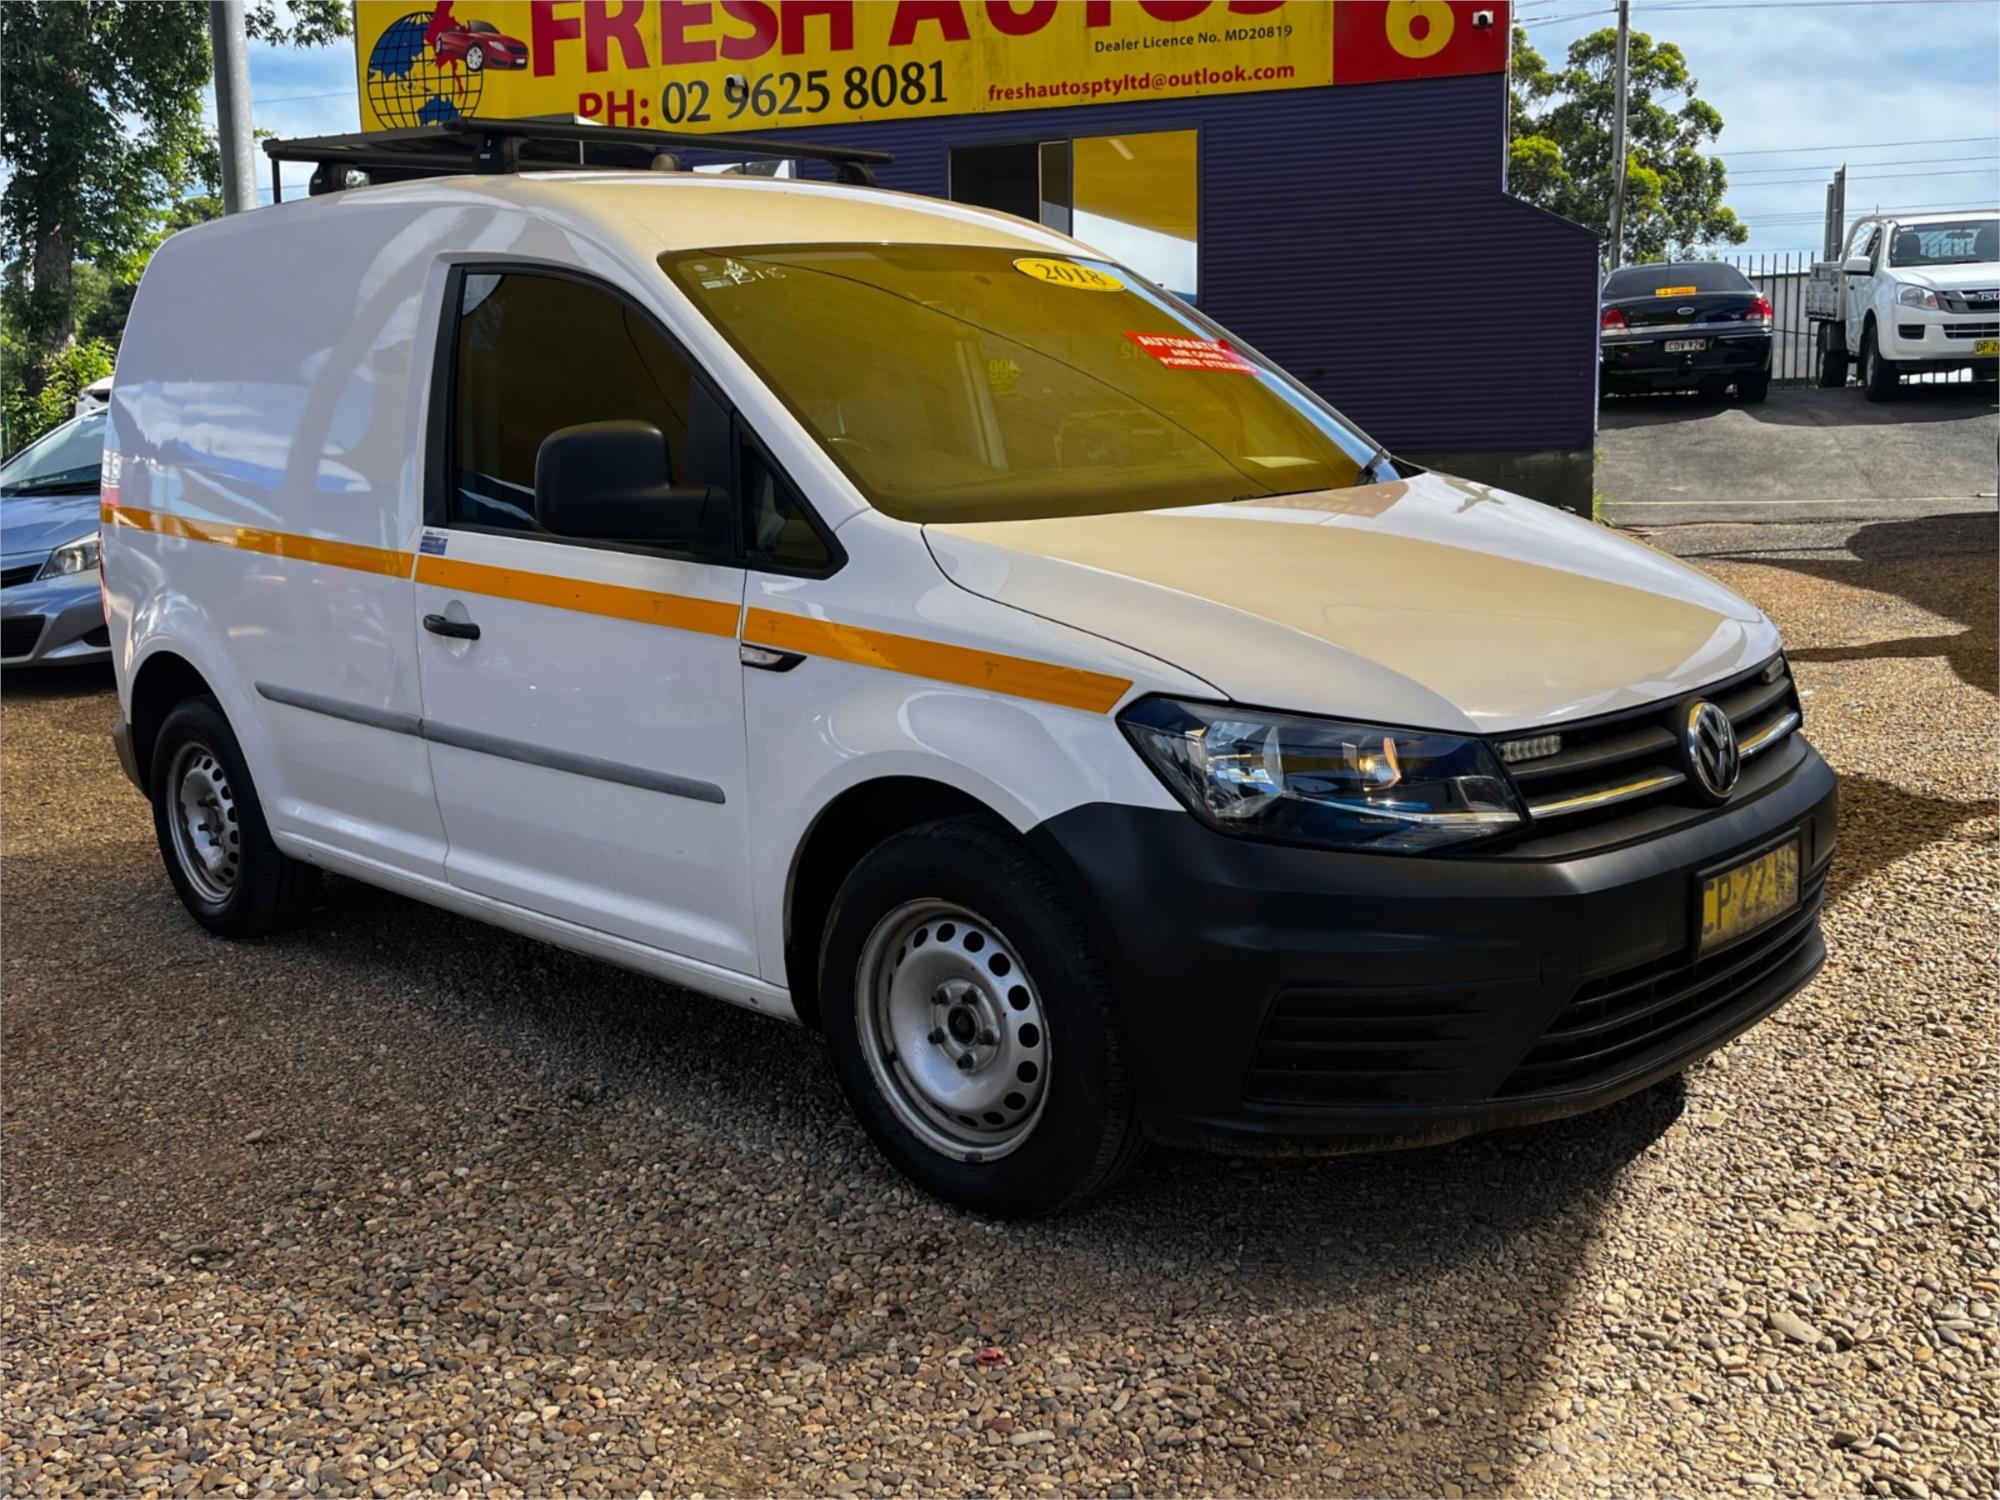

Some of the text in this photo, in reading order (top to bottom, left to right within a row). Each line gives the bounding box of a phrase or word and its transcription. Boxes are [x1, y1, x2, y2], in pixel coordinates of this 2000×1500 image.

[1095, 24, 1293, 53] Dealer Licence No. MD20819
[579, 60, 949, 128] PH: 02 9625 8081
[988, 65, 1295, 101] freshautosptyltd@outlook.com
[1034, 263, 1106, 286] 2018
